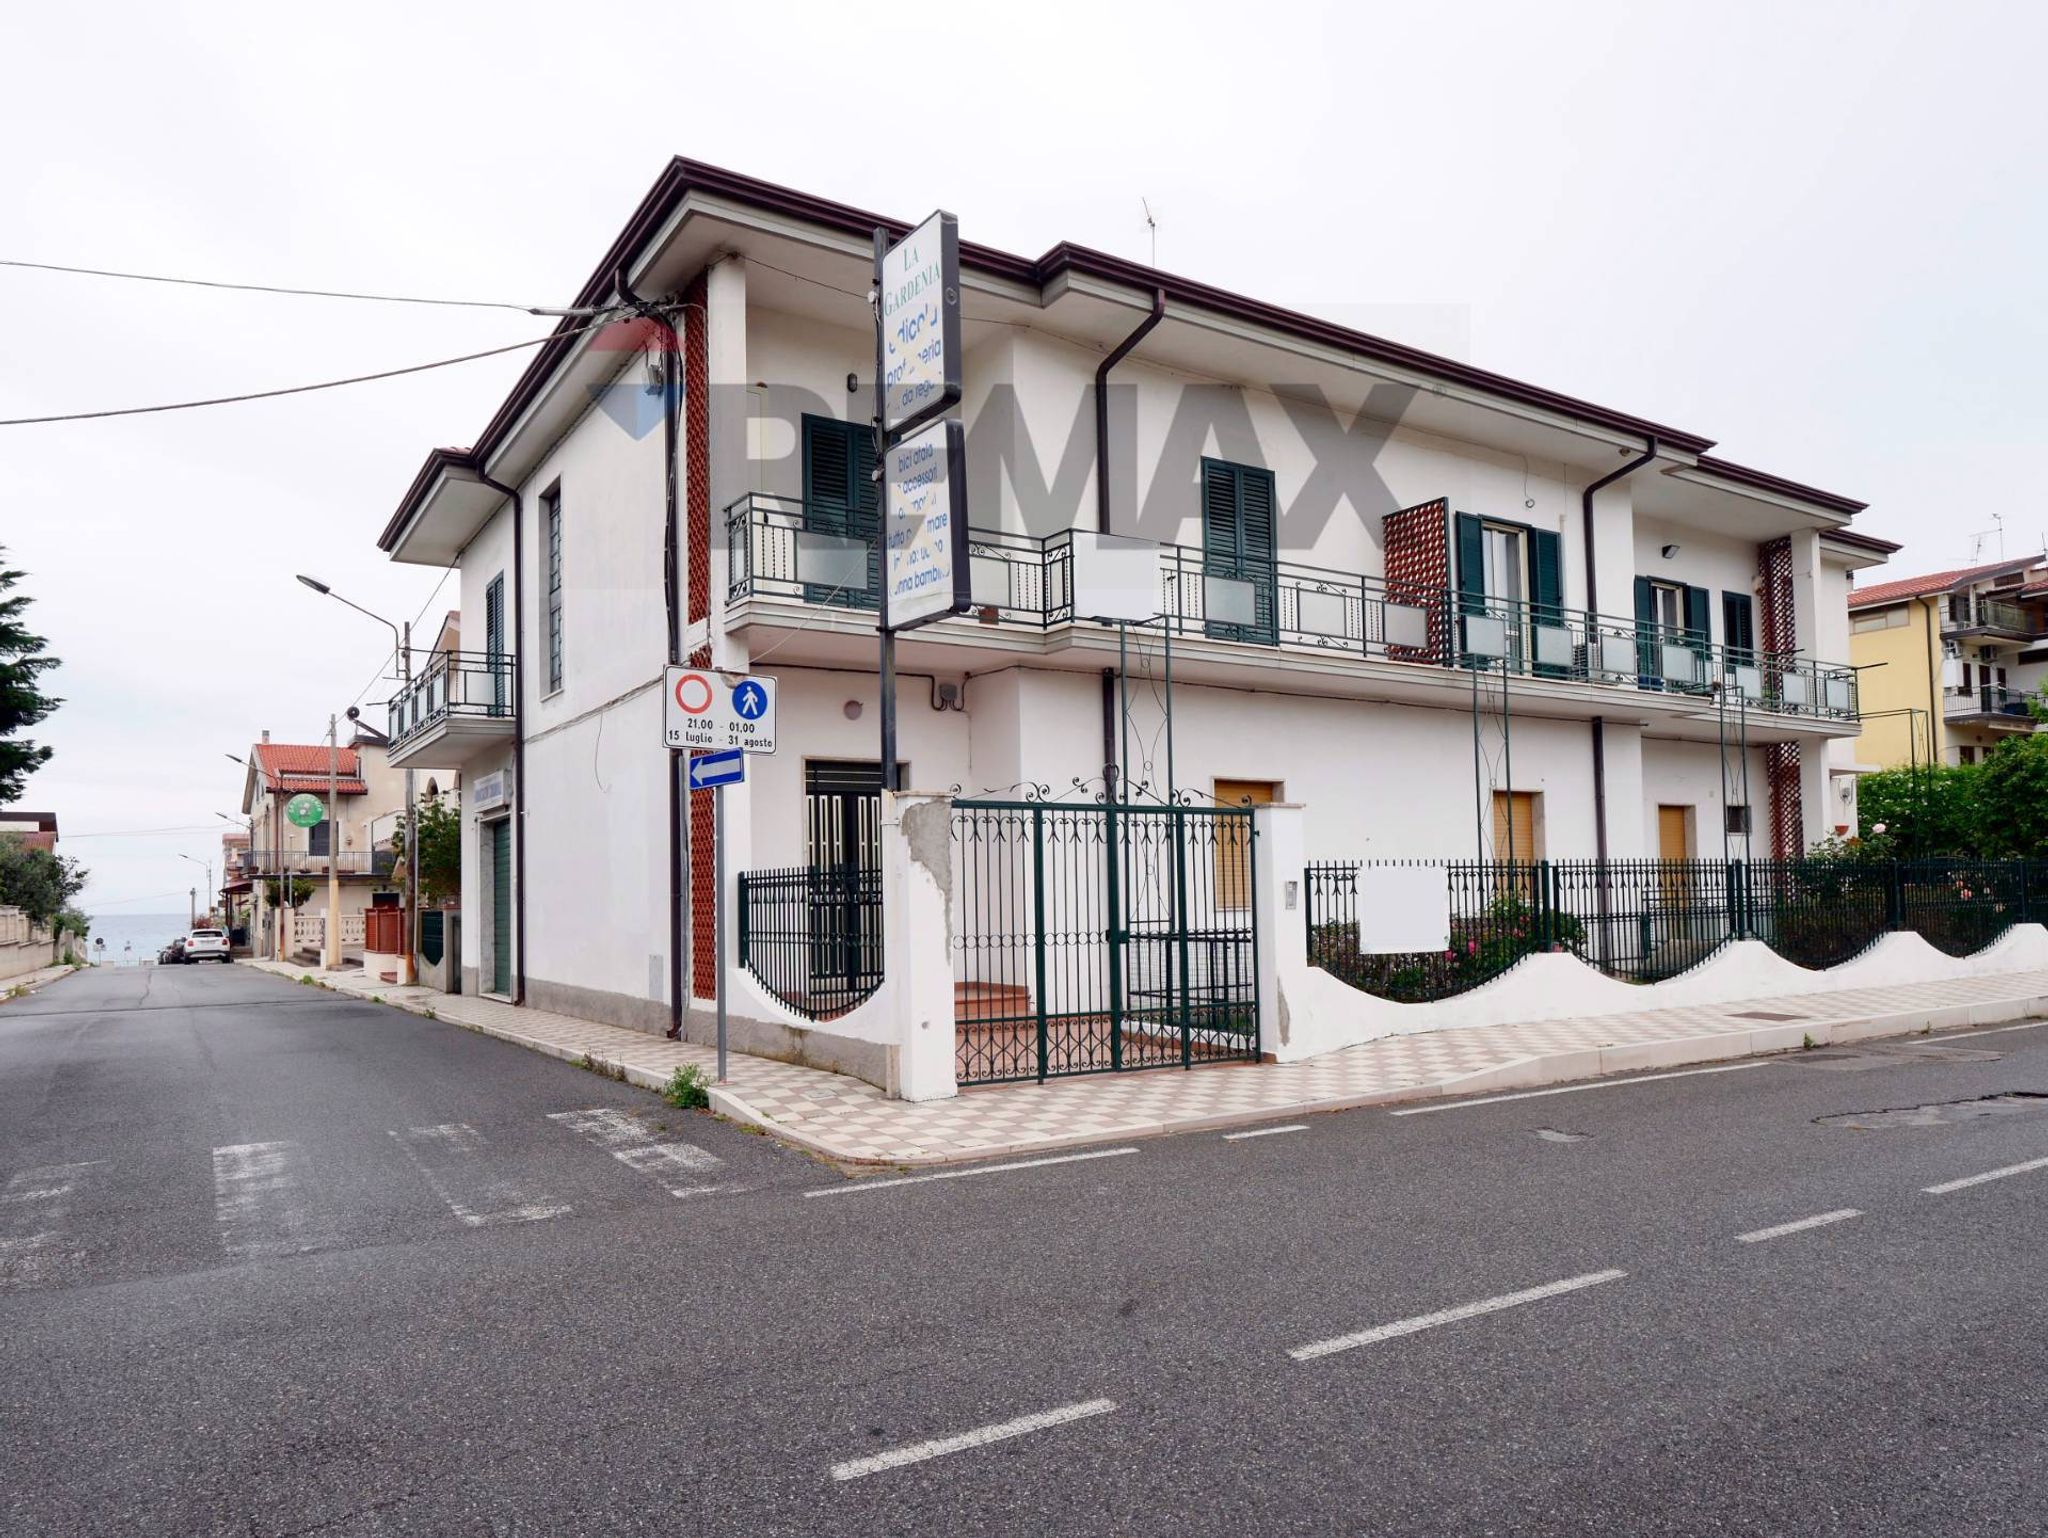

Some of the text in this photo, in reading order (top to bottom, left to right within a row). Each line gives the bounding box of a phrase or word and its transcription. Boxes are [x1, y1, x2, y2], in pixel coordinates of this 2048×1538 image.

[903, 246, 919, 272] LA
[884, 260, 941, 317] GARDENIA
[926, 511, 948, 534] mare
[687, 718, 713, 729] 21.00
[729, 721, 755, 733] 01.00
[669, 730, 680, 740] 15
[685, 731, 713, 744] luglio
[728, 735, 739, 745] 31
[743, 738, 773, 748] agosto
